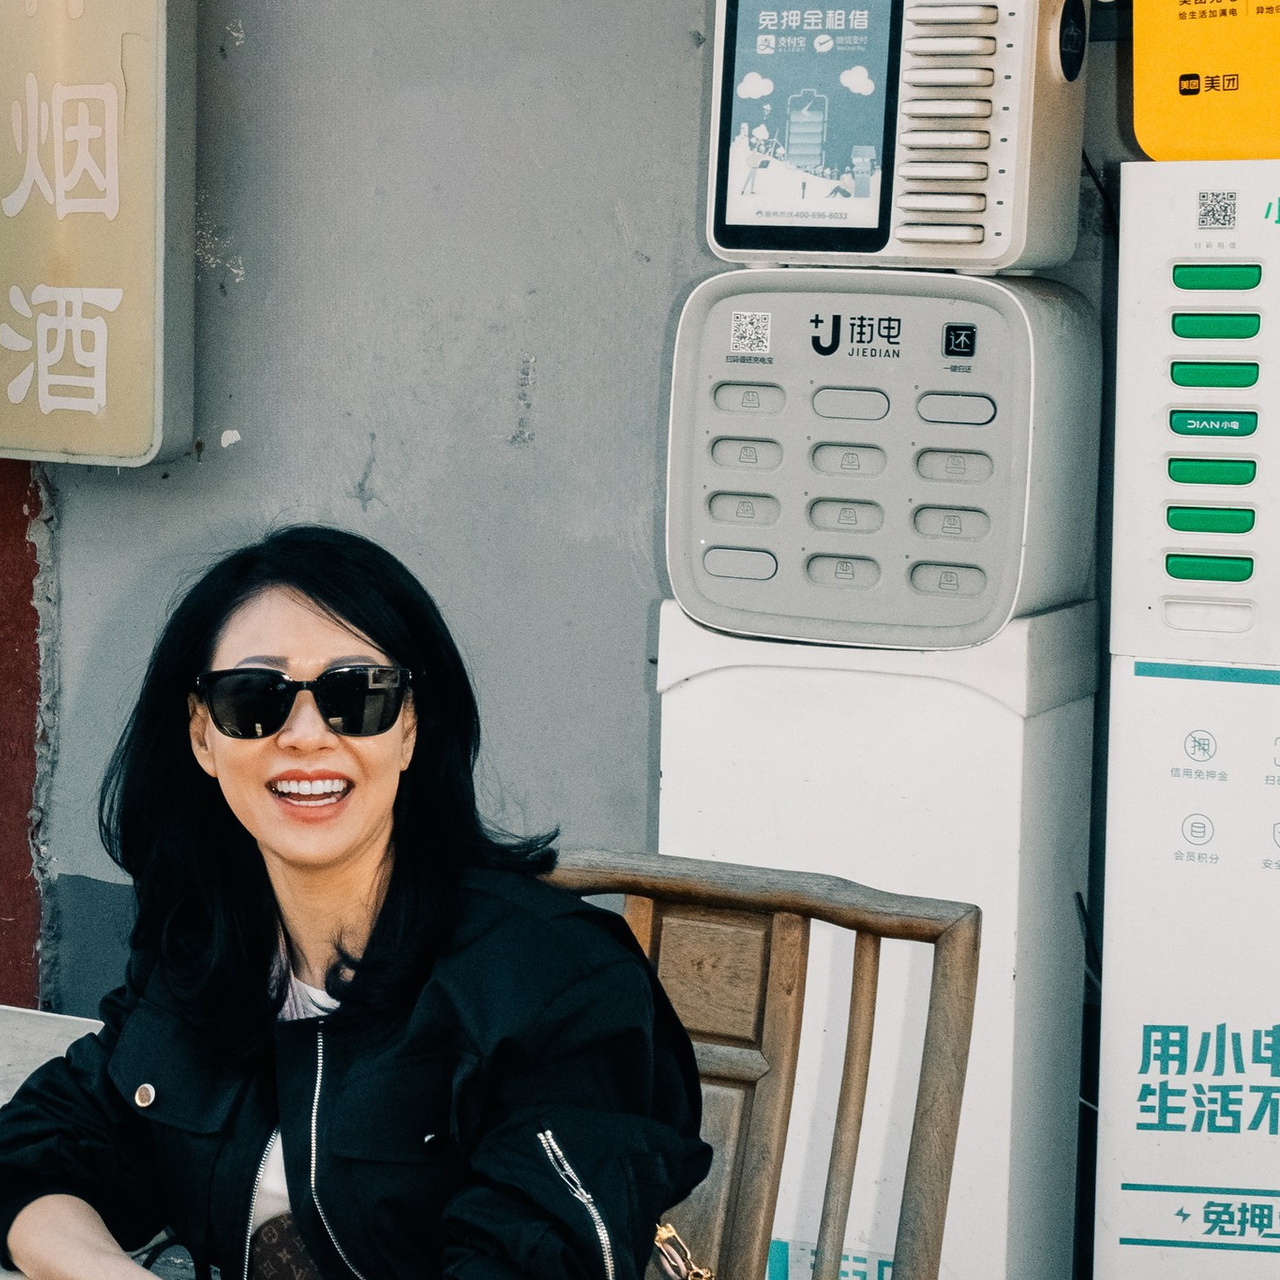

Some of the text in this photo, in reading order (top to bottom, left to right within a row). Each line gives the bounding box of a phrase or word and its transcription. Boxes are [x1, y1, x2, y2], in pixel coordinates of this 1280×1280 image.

[758, 9, 869, 30] 免押金租借
[778, 36, 806, 47] 支付宝
[1204, 74, 1239, 92] 美团
[849, 316, 901, 345] 街电
[949, 330, 971, 352] 还
[848, 347, 901, 359] JIEDIAN
[1170, 767, 1229, 782] 信用免押金
[1173, 850, 1219, 864] 会员积分
[1203, 1200, 1280, 1238] 免押
